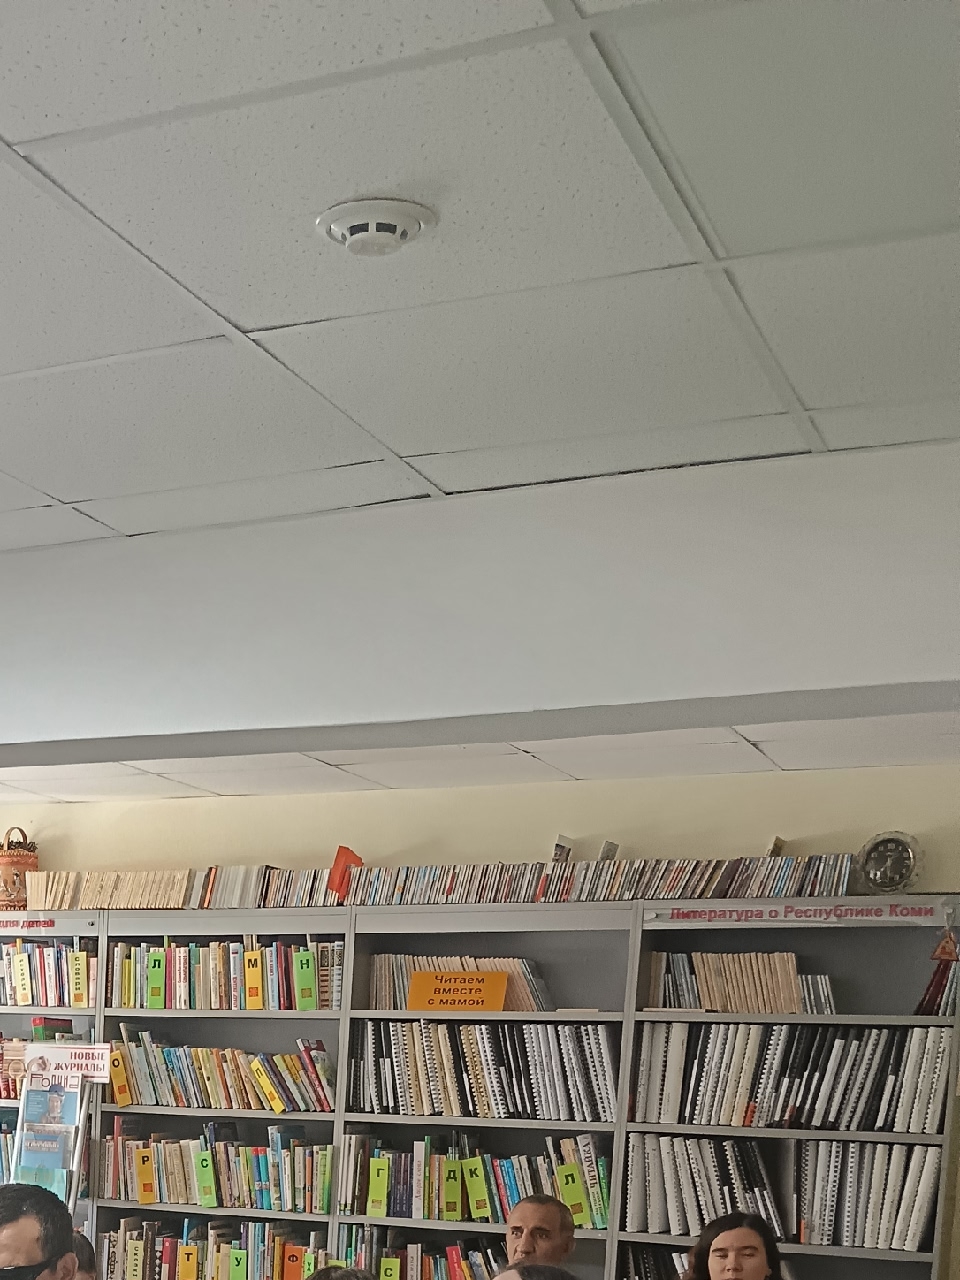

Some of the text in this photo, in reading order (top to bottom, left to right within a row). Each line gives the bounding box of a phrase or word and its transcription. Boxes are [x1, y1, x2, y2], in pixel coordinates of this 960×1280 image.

[669, 903, 934, 922] Литература о Республике Коми
[21, 917, 55, 930] детей
[151, 958, 162, 969] Л
[246, 957, 259, 969] М
[299, 958, 310, 970] Н
[434, 975, 485, 984] Читаем
[433, 987, 482, 995] вместе
[438, 996, 485, 1006] мамой
[70, 1051, 105, 1061] НОВЫЕ
[53, 1062, 105, 1072] ЖУРНАЛЫ
[376, 1167, 385, 1178] Г
[445, 1169, 458, 1182] Д
[468, 1167, 480, 1179] К
